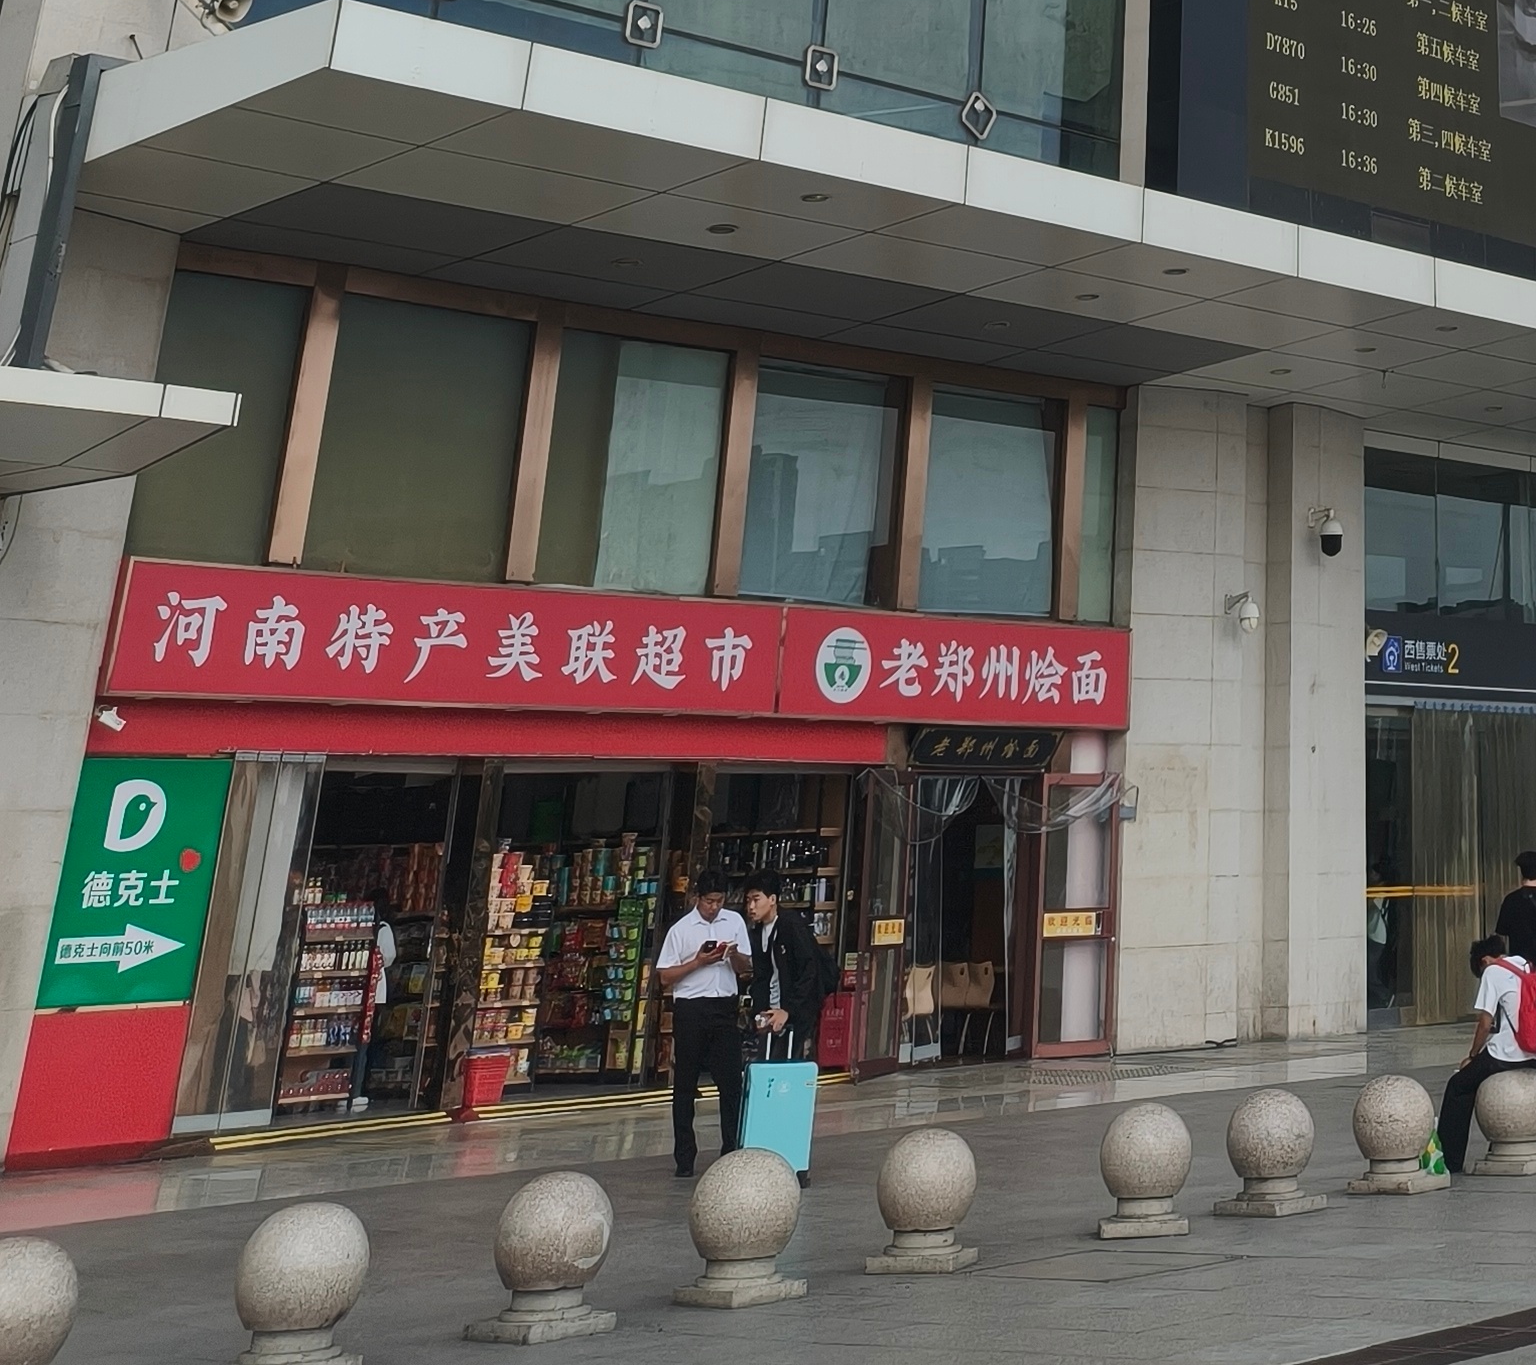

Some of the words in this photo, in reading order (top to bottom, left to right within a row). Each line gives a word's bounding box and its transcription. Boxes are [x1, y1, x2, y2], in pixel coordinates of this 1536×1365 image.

[1340, 11, 1377, 37] 16:26
[1416, 32, 1480, 72] 第五候车室
[1266, 32, 1305, 60] D7870
[1340, 56, 1377, 82] 16:30
[1417, 76, 1481, 115] 第四候车室
[1269, 81, 1300, 106] G851
[1340, 103, 1378, 128] 16:30
[1265, 128, 1305, 156] K1596
[1340, 149, 1378, 175] 16:36
[1418, 167, 1483, 205] 第二候车室
[153, 591, 755, 691] 河南特产美联超市
[879, 637, 1109, 706] 老郑州烩面
[1404, 640, 1447, 661] 西售票处
[1447, 644, 1459, 674] 2
[81, 869, 180, 909] 德克士
[59, 940, 154, 960] 德克士向前50米
